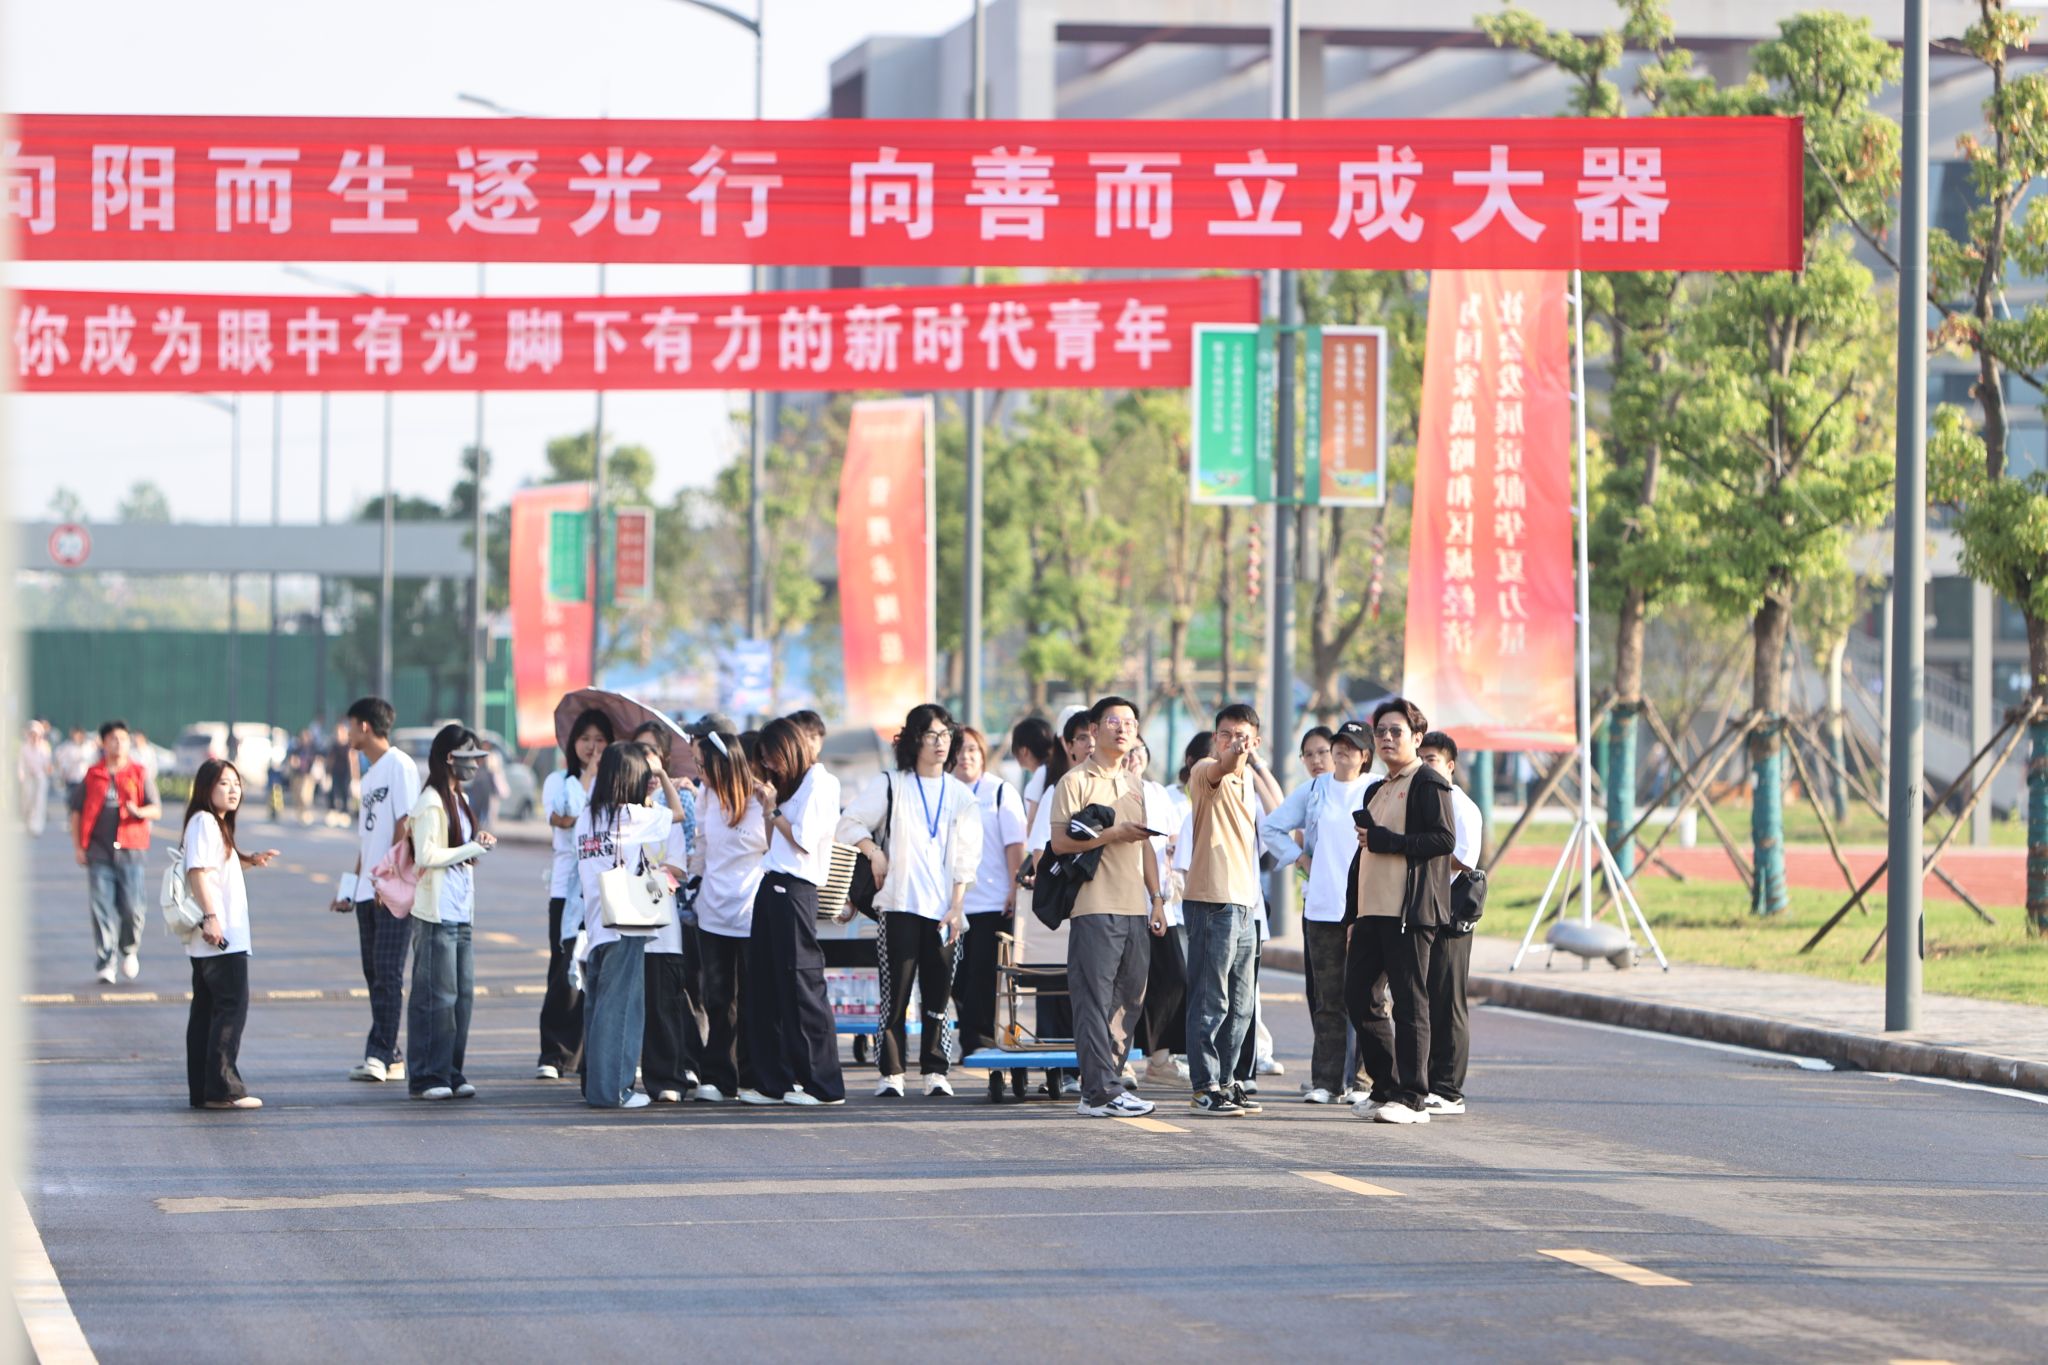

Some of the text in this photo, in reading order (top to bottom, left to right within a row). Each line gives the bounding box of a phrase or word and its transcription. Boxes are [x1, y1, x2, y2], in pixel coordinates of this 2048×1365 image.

[0, 141, 1670, 243] 向阳而生逐光行 向善而立成大器
[13, 298, 1172, 377] 你成为眼中有光 脚下有力的新时代青年
